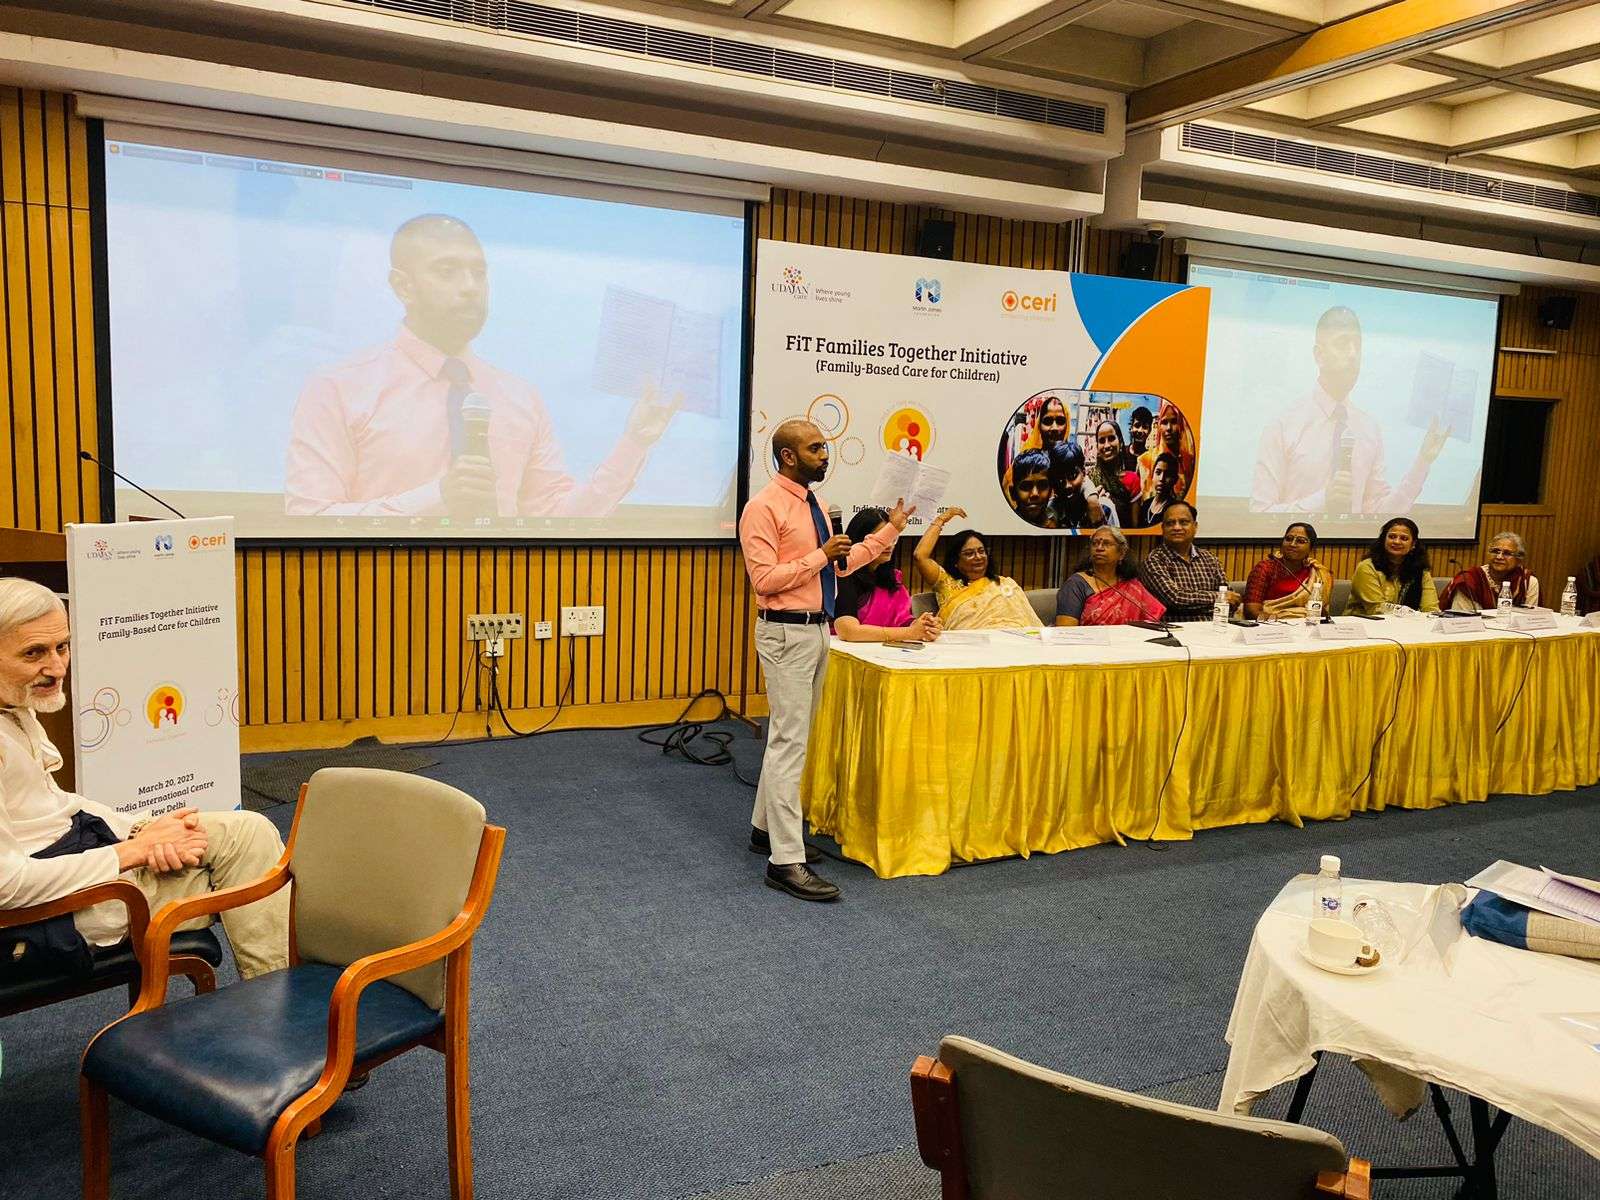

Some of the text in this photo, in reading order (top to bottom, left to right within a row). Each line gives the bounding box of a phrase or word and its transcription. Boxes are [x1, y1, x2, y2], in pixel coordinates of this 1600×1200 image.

[834, 290, 851, 298] young
[1020, 293, 1057, 312] ceri
[786, 335, 1028, 366] FiT Families Together Initiative
[816, 360, 1000, 383] (Family-Based Care for Children)
[201, 533, 226, 547] ceri
[100, 604, 219, 626] FiT Families Together Initiative
[98, 616, 221, 641] (Family-Based Care for Children
[138, 773, 194, 795] March 20, 2023
[116, 780, 215, 813] India International Centre
[151, 800, 187, 817] ew Delhi
